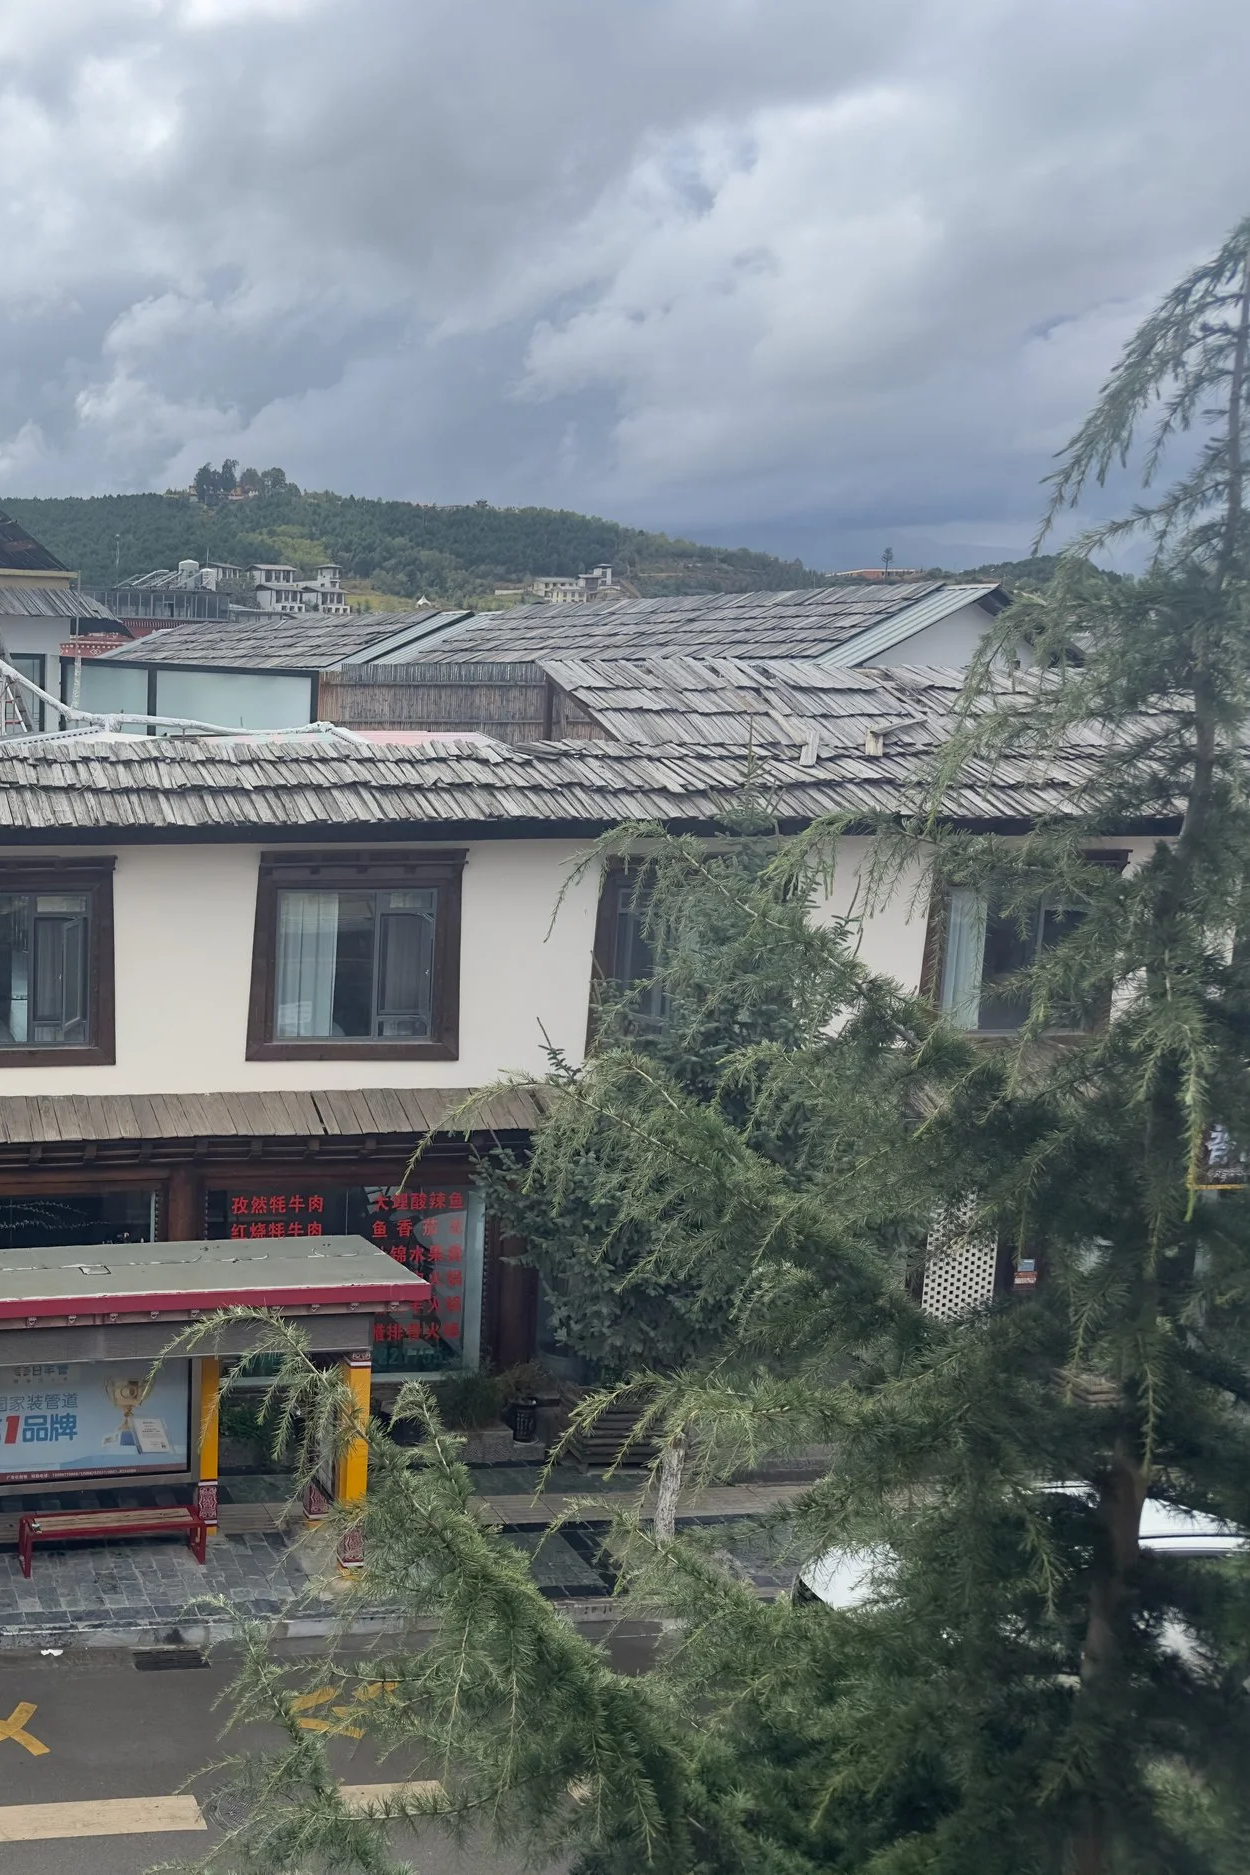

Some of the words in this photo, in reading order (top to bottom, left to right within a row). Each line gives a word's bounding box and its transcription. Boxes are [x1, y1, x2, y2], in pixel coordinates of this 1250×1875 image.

[231, 1195, 324, 1214] 孜然牦牛肉
[373, 1191, 463, 1211] 大理酸辣鱼
